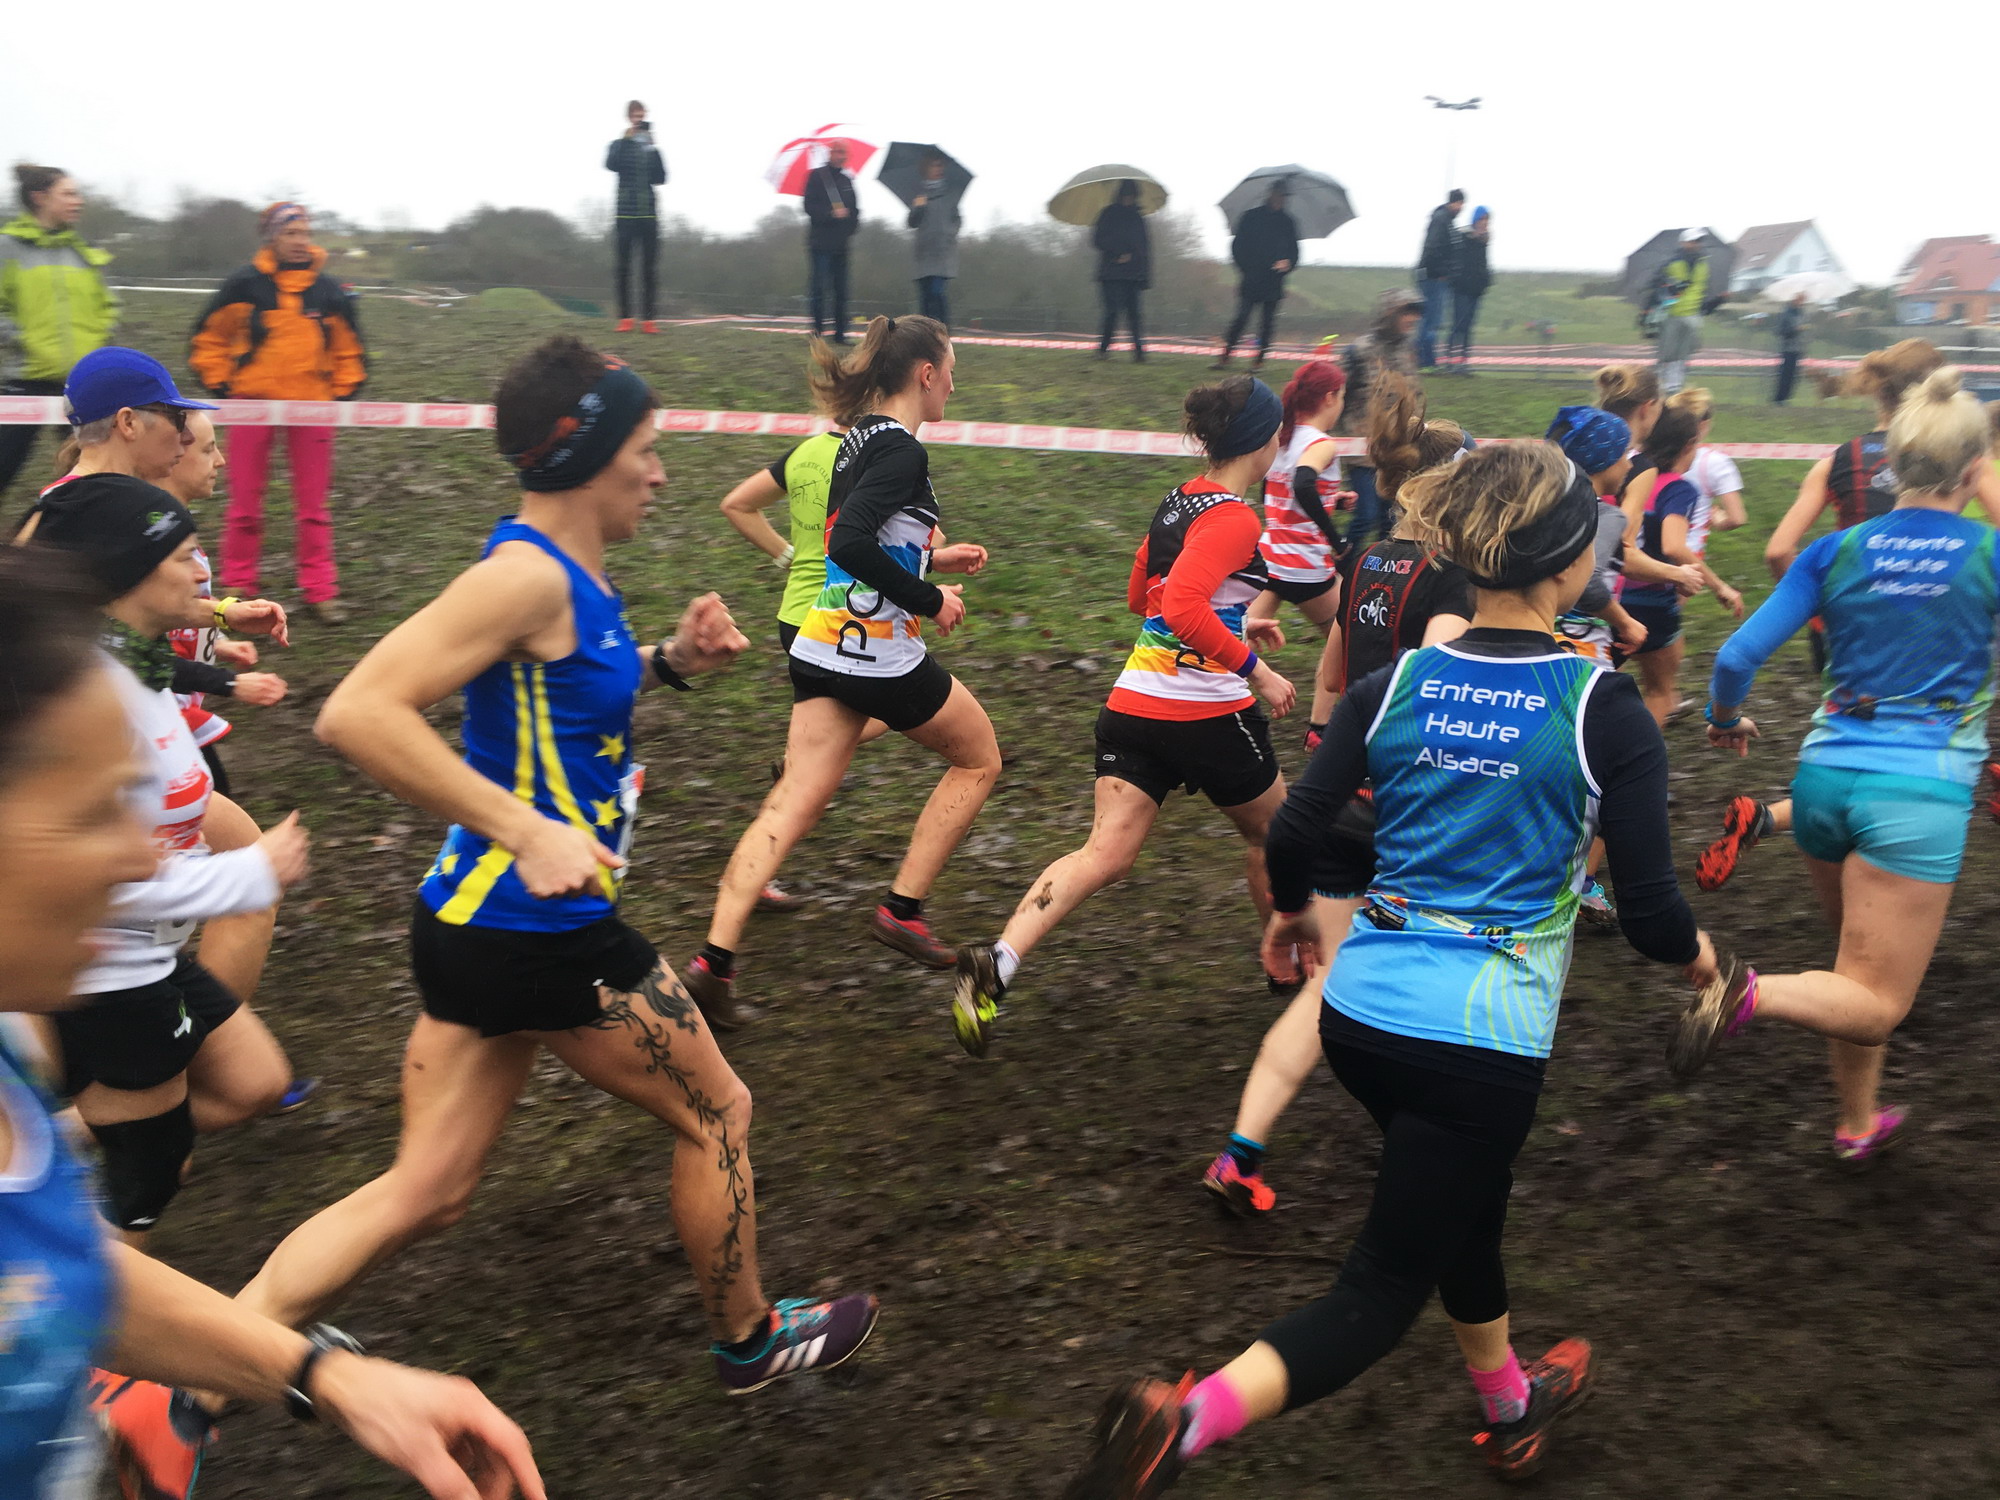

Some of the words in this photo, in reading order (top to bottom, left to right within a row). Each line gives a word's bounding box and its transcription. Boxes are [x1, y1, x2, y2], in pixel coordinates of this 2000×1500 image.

[1363, 555, 1414, 575] FRANCE
[1419, 679, 1546, 712] Entente
[1424, 712, 1521, 743] Haute
[1414, 747, 1520, 780] Alsace
